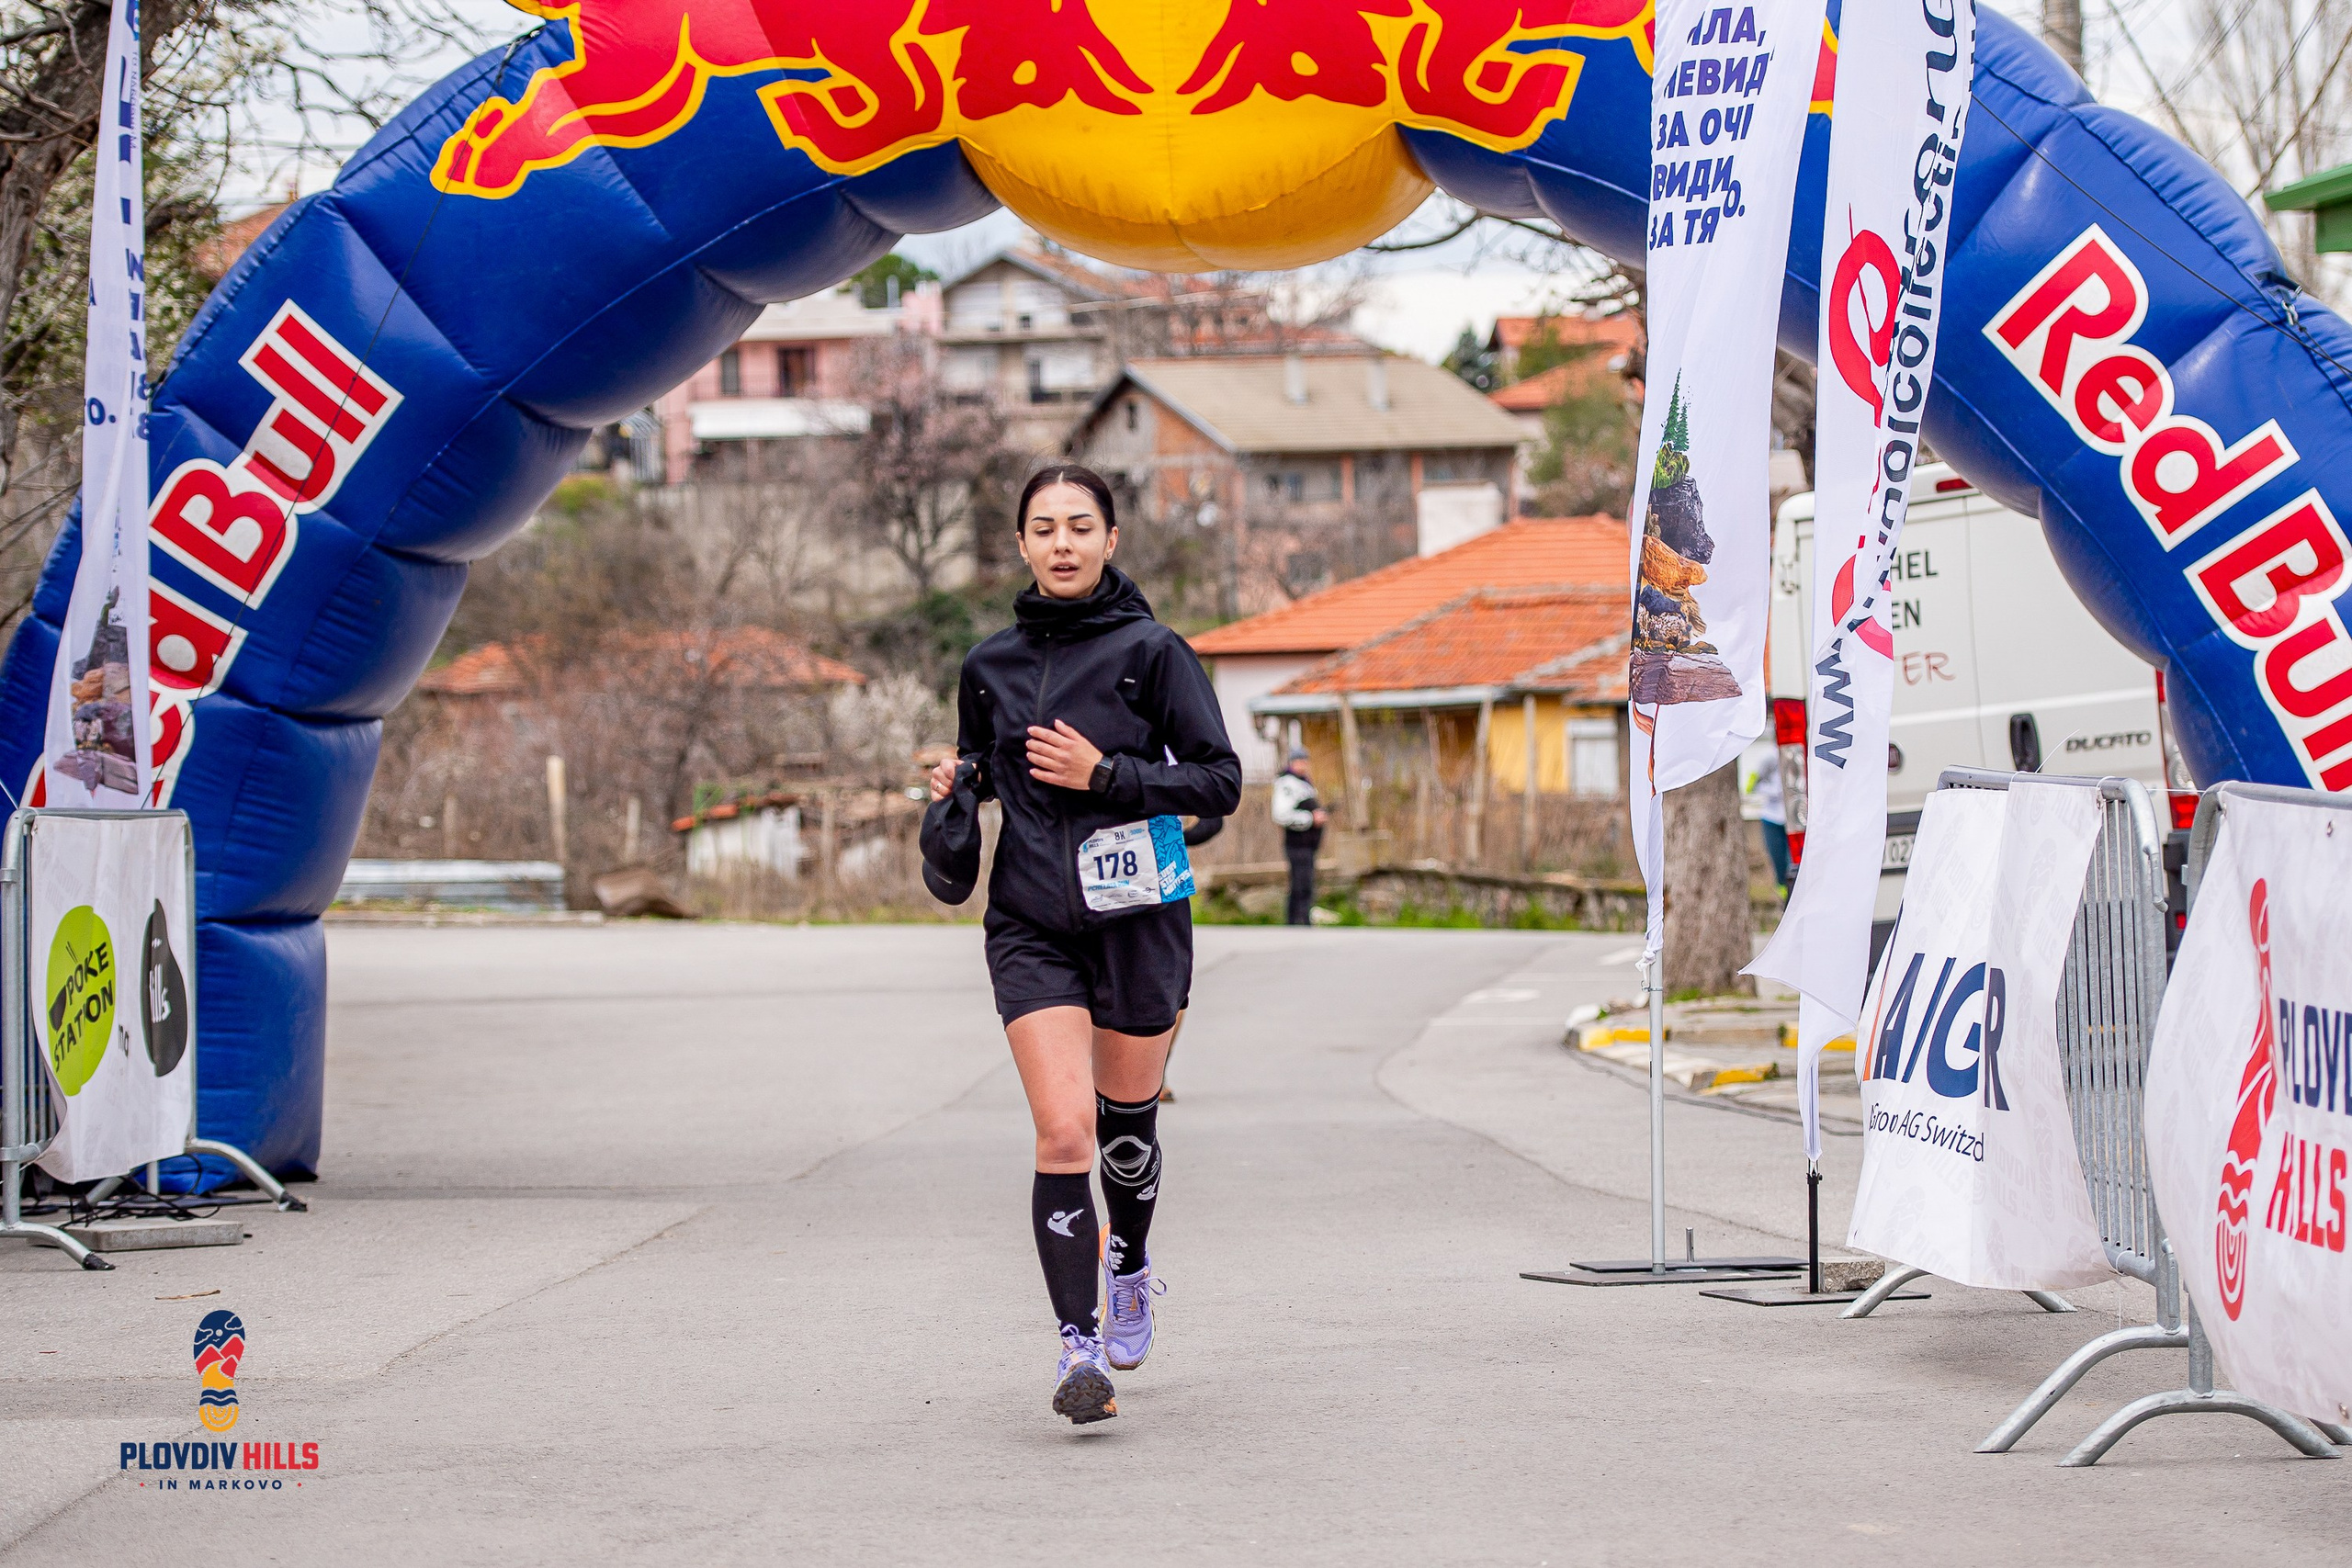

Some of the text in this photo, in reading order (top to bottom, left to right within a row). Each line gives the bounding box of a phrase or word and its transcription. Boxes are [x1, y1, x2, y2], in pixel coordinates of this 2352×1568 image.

[1657, 110, 1690, 151] ЗА
[1989, 230, 2291, 544] Red
[147, 307, 396, 603] Bull
[1890, 548, 1939, 581] HEL
[1892, 599, 1922, 629] EN
[2065, 730, 2152, 751] DUCATO
[1114, 830, 1126, 840] 8K
[1093, 850, 1138, 881] 178
[65, 942, 109, 1006] POKE
[1896, 1110, 1924, 1138] AG
